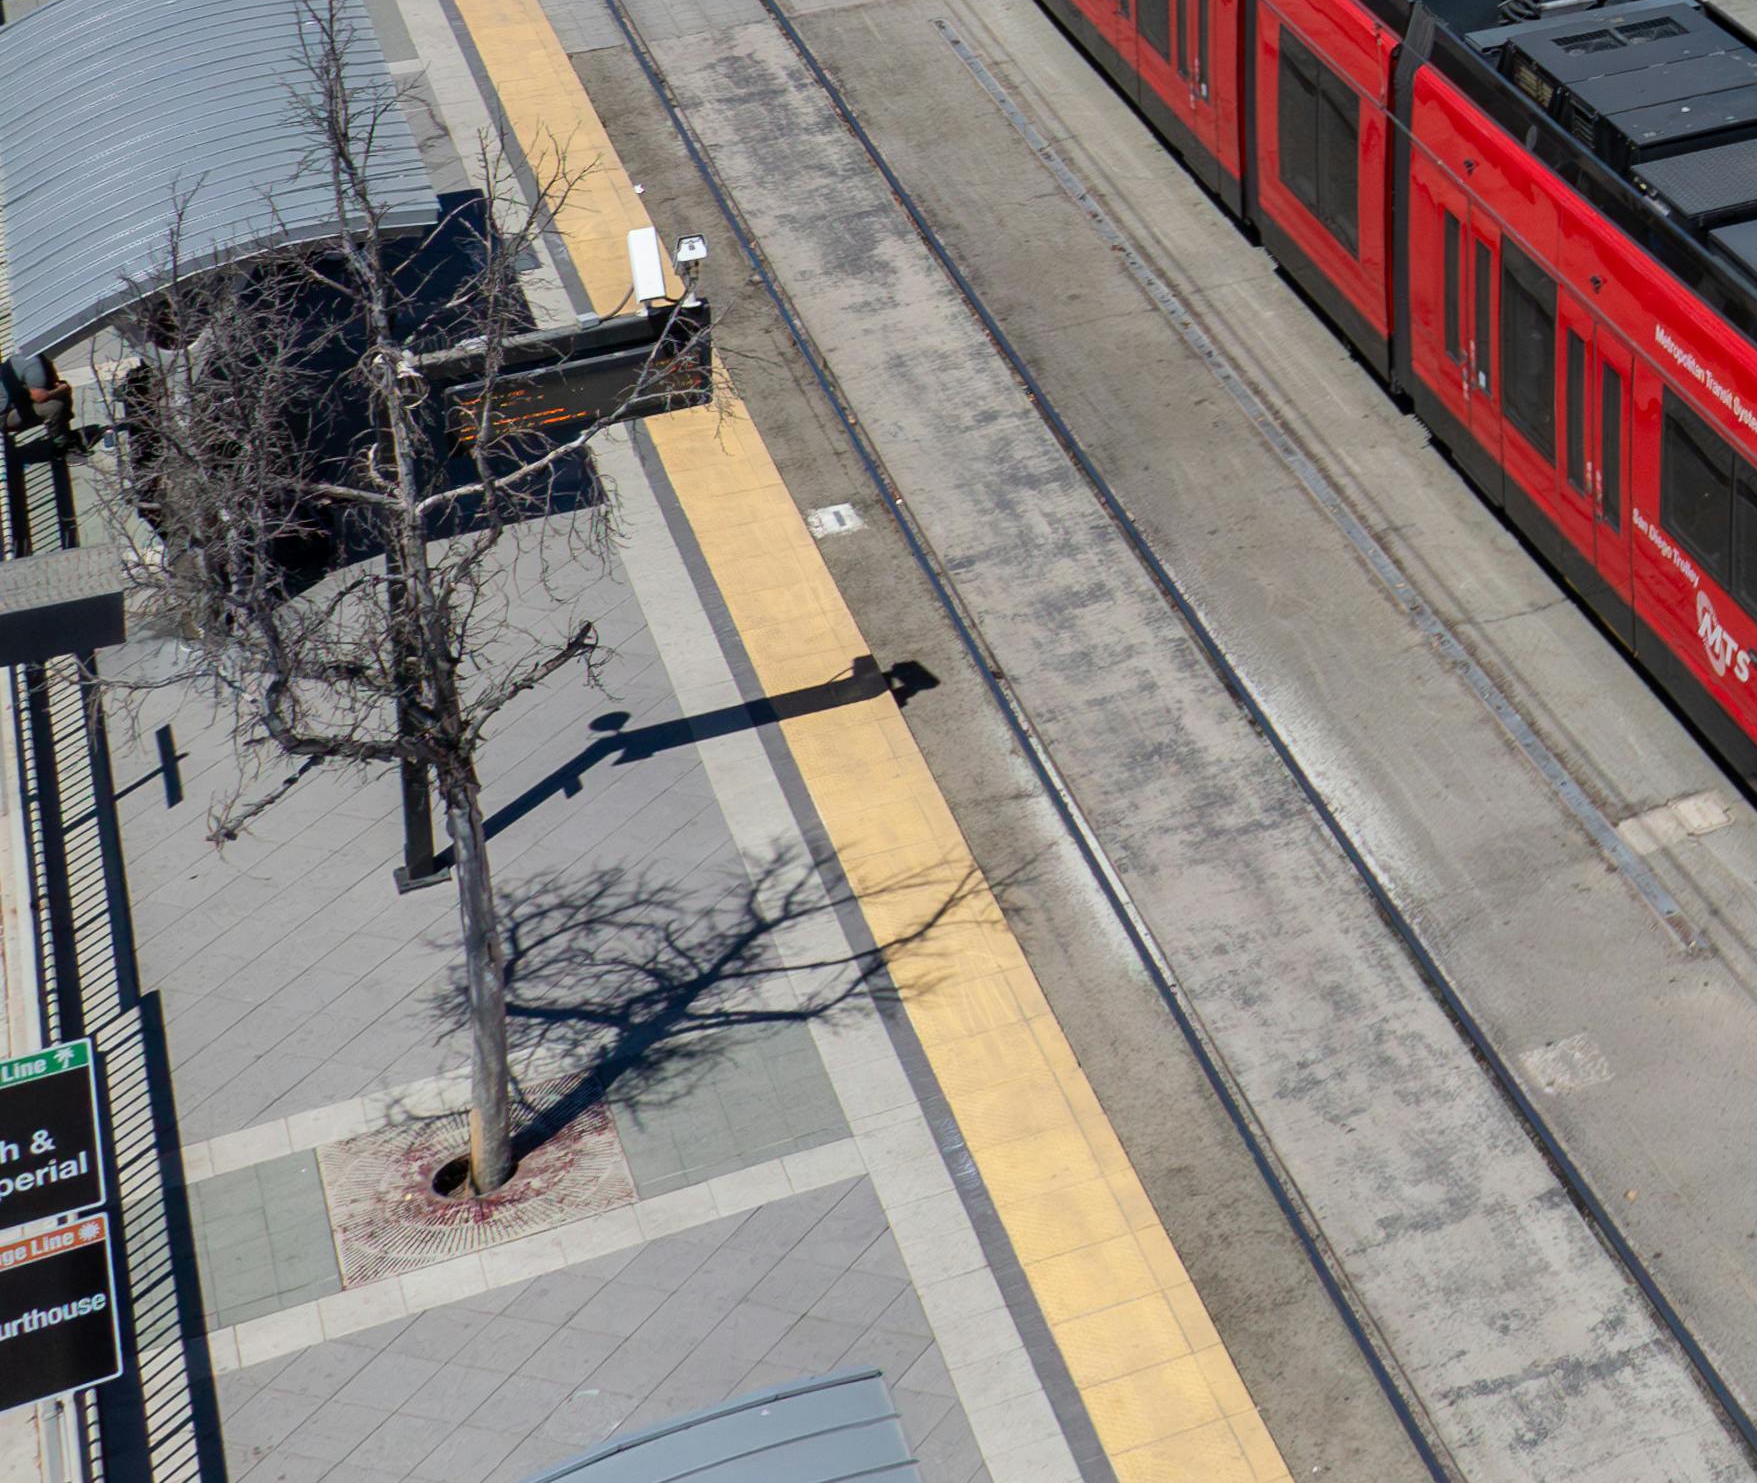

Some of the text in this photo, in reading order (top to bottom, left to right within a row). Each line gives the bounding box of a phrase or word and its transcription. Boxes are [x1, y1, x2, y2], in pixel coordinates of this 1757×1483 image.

[1655, 324, 1705, 384] Metropolitan
[1706, 368, 1733, 409] Transit
[1697, 611, 1751, 683] MTS
[2, 1058, 47, 1083] Line
[30, 1128, 56, 1155] &
[31, 1231, 75, 1257] Line
